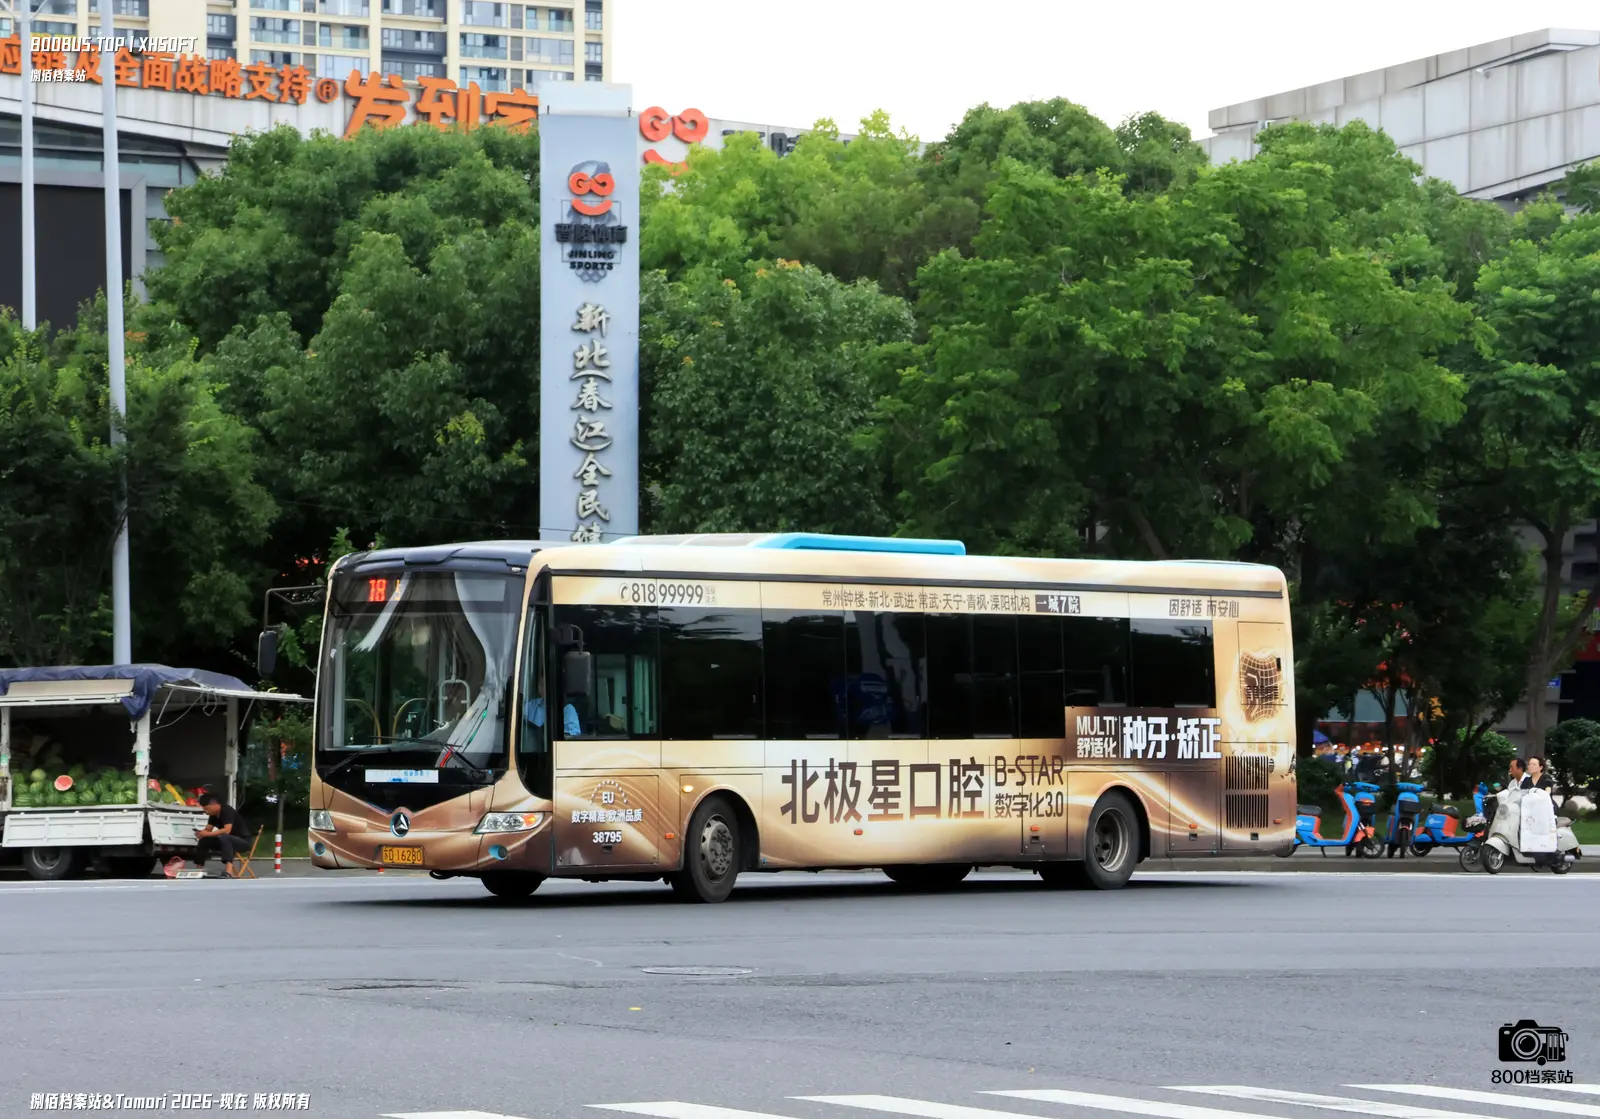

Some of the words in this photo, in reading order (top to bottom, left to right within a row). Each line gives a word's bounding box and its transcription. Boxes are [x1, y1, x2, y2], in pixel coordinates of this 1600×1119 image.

[568, 250, 615, 259] JINLING
[569, 261, 614, 270] SPORTS
[368, 578, 387, 602] 18
[631, 583, 704, 604] 81899999
[1076, 737, 1117, 758] 舒适化
[1122, 715, 1222, 759] 种牙·矫正
[994, 755, 1064, 787] B-STAR
[602, 791, 615, 804] EU
[780, 757, 985, 825] 北极星口腔
[994, 791, 1064, 818] 数字化3.0
[592, 831, 622, 843] 38795
